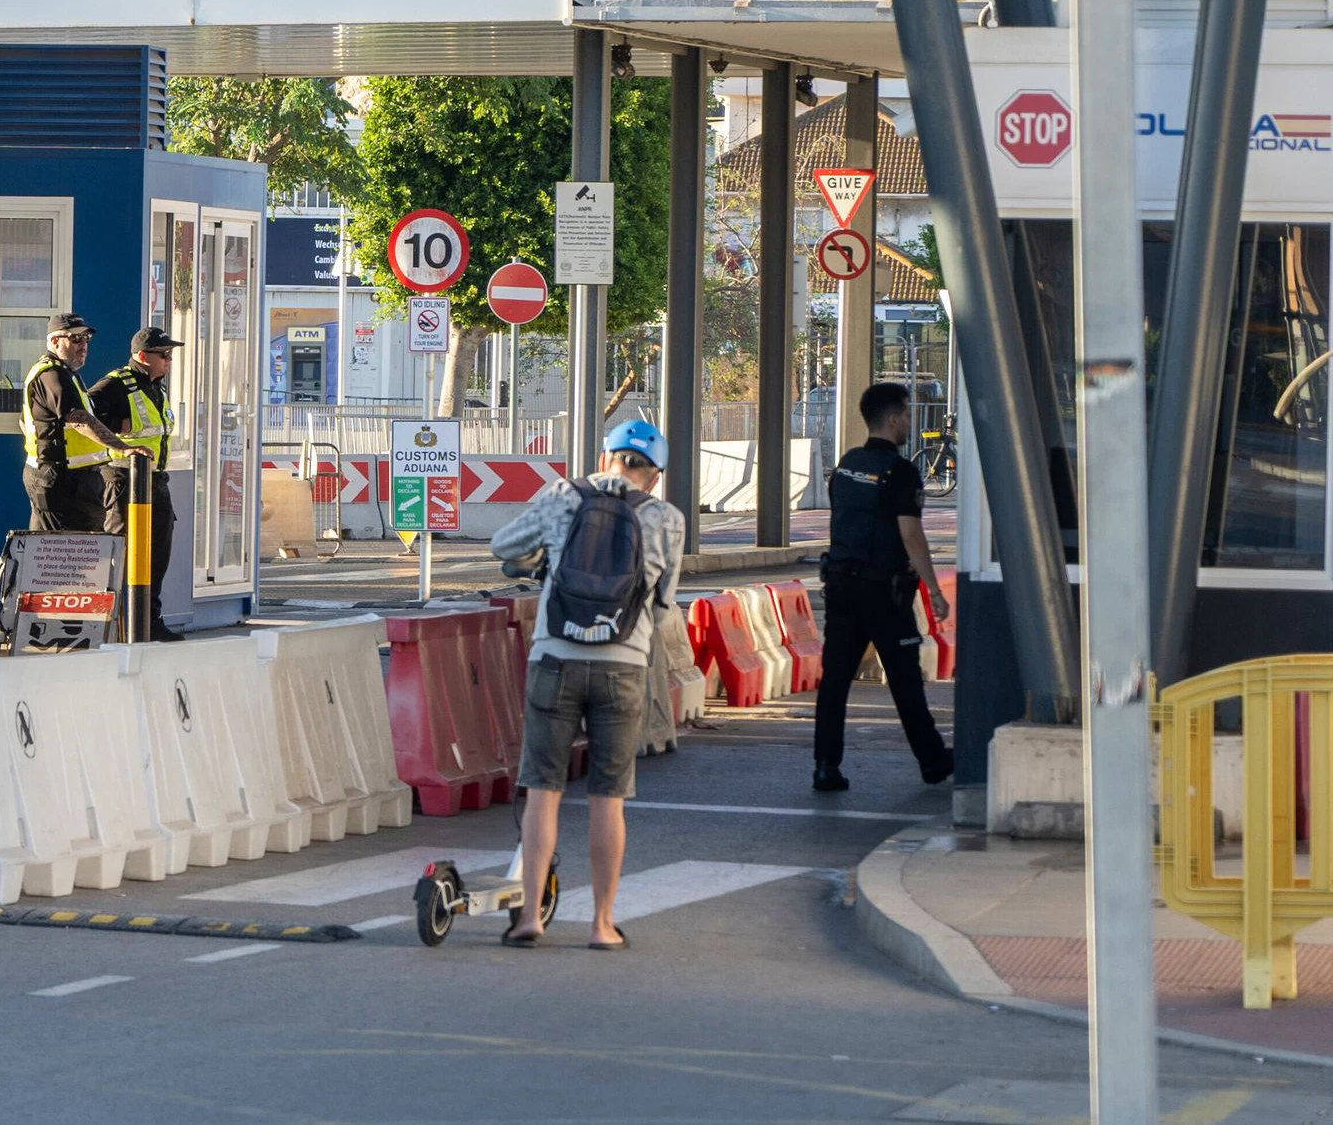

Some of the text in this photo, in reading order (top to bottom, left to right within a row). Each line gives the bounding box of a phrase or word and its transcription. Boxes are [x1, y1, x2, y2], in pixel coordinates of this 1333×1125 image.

[1004, 113, 1068, 145] STOP
[827, 177, 862, 189] GIVE
[834, 192, 857, 200] WAY
[404, 232, 453, 269] 10
[413, 300, 446, 309] NO IDLING
[294, 330, 320, 339] ATM
[395, 451, 457, 462] CUSTOMS
[403, 463, 448, 473] ADUANA
[41, 595, 93, 609] STOP
